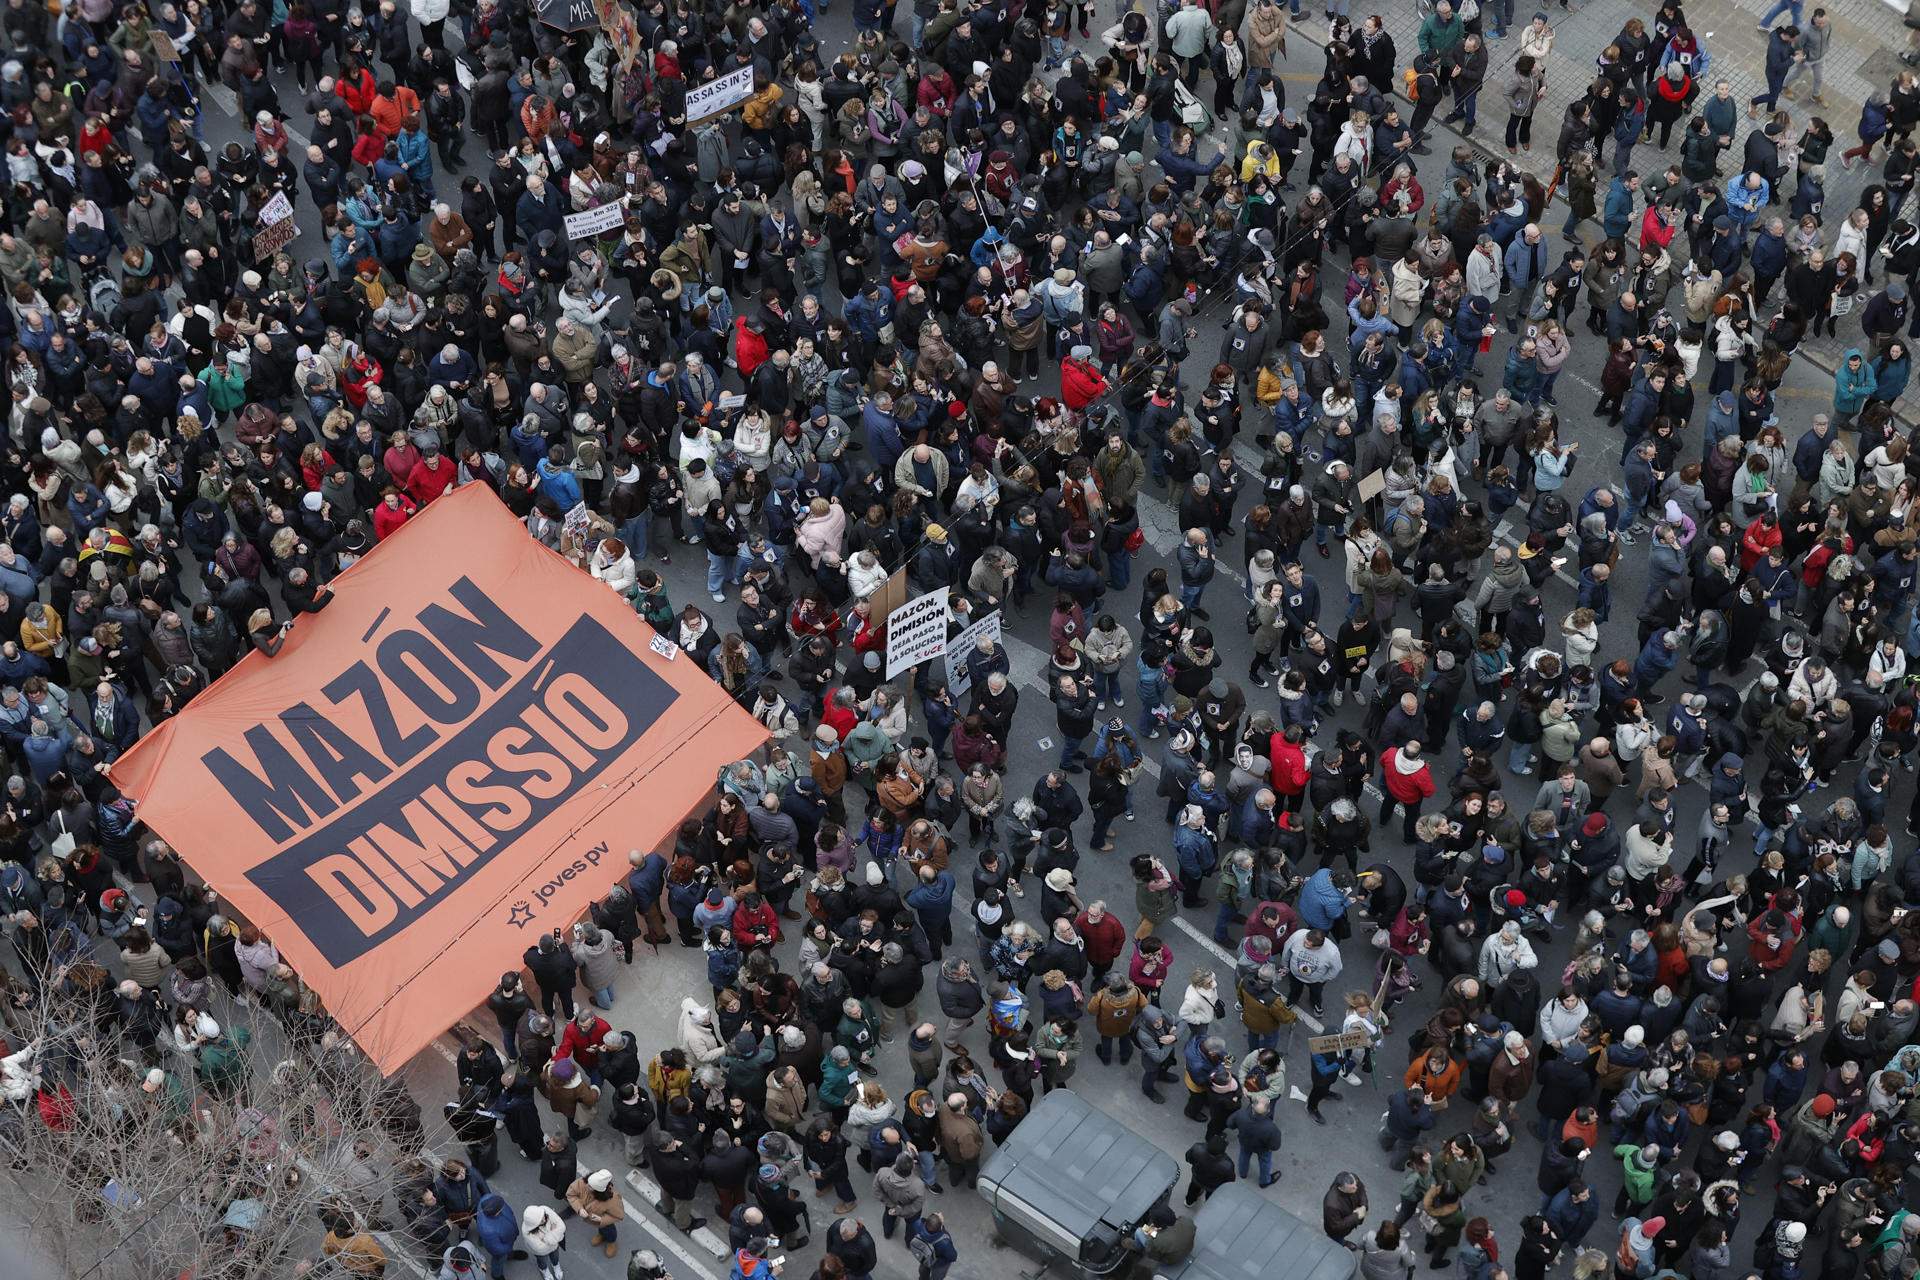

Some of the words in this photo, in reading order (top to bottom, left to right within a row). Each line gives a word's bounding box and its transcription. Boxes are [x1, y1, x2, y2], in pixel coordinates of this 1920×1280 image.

[570, 0, 596, 22] MA
[605, 204, 618, 213] 322
[890, 607, 945, 641] DIMISIÓN
[891, 597, 938, 627] MAZÓN,
[889, 654, 899, 665] LA
[900, 633, 944, 657] SOLUCIÓN
[892, 636, 912, 652] DEJA
[912, 625, 935, 641] PASO
[937, 622, 944, 630] A
[952, 652, 959, 660] NO
[200, 575, 543, 845] MAZÓN
[303, 658, 629, 938] DIMISSIÓ
[531, 860, 587, 907] joves
[584, 841, 609, 867] pv
